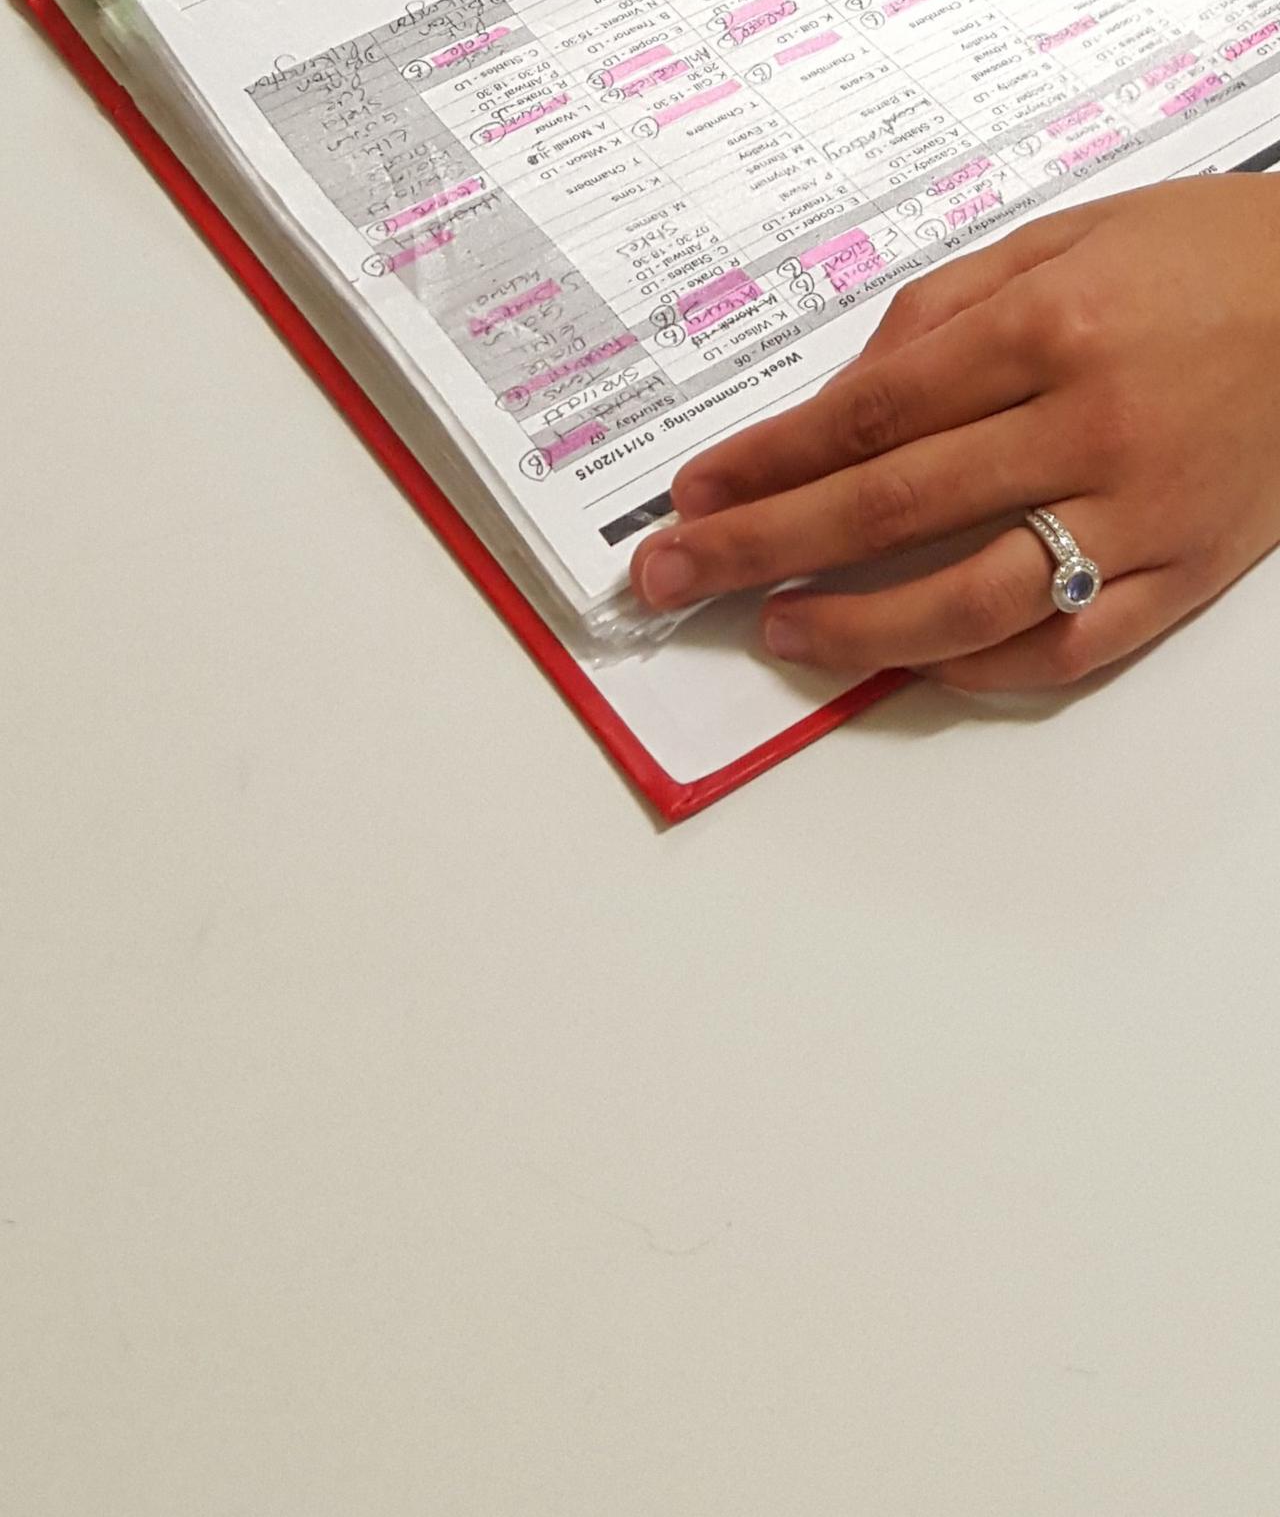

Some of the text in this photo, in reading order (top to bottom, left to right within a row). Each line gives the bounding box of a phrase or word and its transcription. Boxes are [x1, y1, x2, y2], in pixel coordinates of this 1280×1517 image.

[600, 8, 643, 29] Vincent
[909, 2, 961, 28] Chambers
[629, 33, 668, 53] Cooper
[480, 56, 523, 77] Stables
[504, 77, 542, 98] Athwal
[840, 72, 875, 90] Evans
[517, 88, 552, 105] Drake
[535, 112, 577, 134] Warner
[686, 108, 743, 136] Chambers
[727, 126, 763, 146] Evans
[913, 137, 945, 154] Gavin
[566, 146, 607, 165] Wilson
[746, 152, 788, 174] Barnes
[914, 148, 957, 171] Cassidy
[566, 165, 626, 195] Chambers
[611, 185, 646, 202] Toms
[625, 210, 668, 232] Barnes
[803, 205, 844, 228] Cooper
[968, 198, 1035, 234] Wednesday
[662, 242, 701, 267] Athwal
[668, 254, 712, 279] Stables
[687, 266, 724, 287] Drake
[864, 259, 922, 291] Thursday
[730, 320, 772, 344] Wilson
[761, 326, 801, 351] Friday
[576, 352, 802, 480] Week Commencing: 01/11/2015
[616, 396, 675, 429] Saturday
